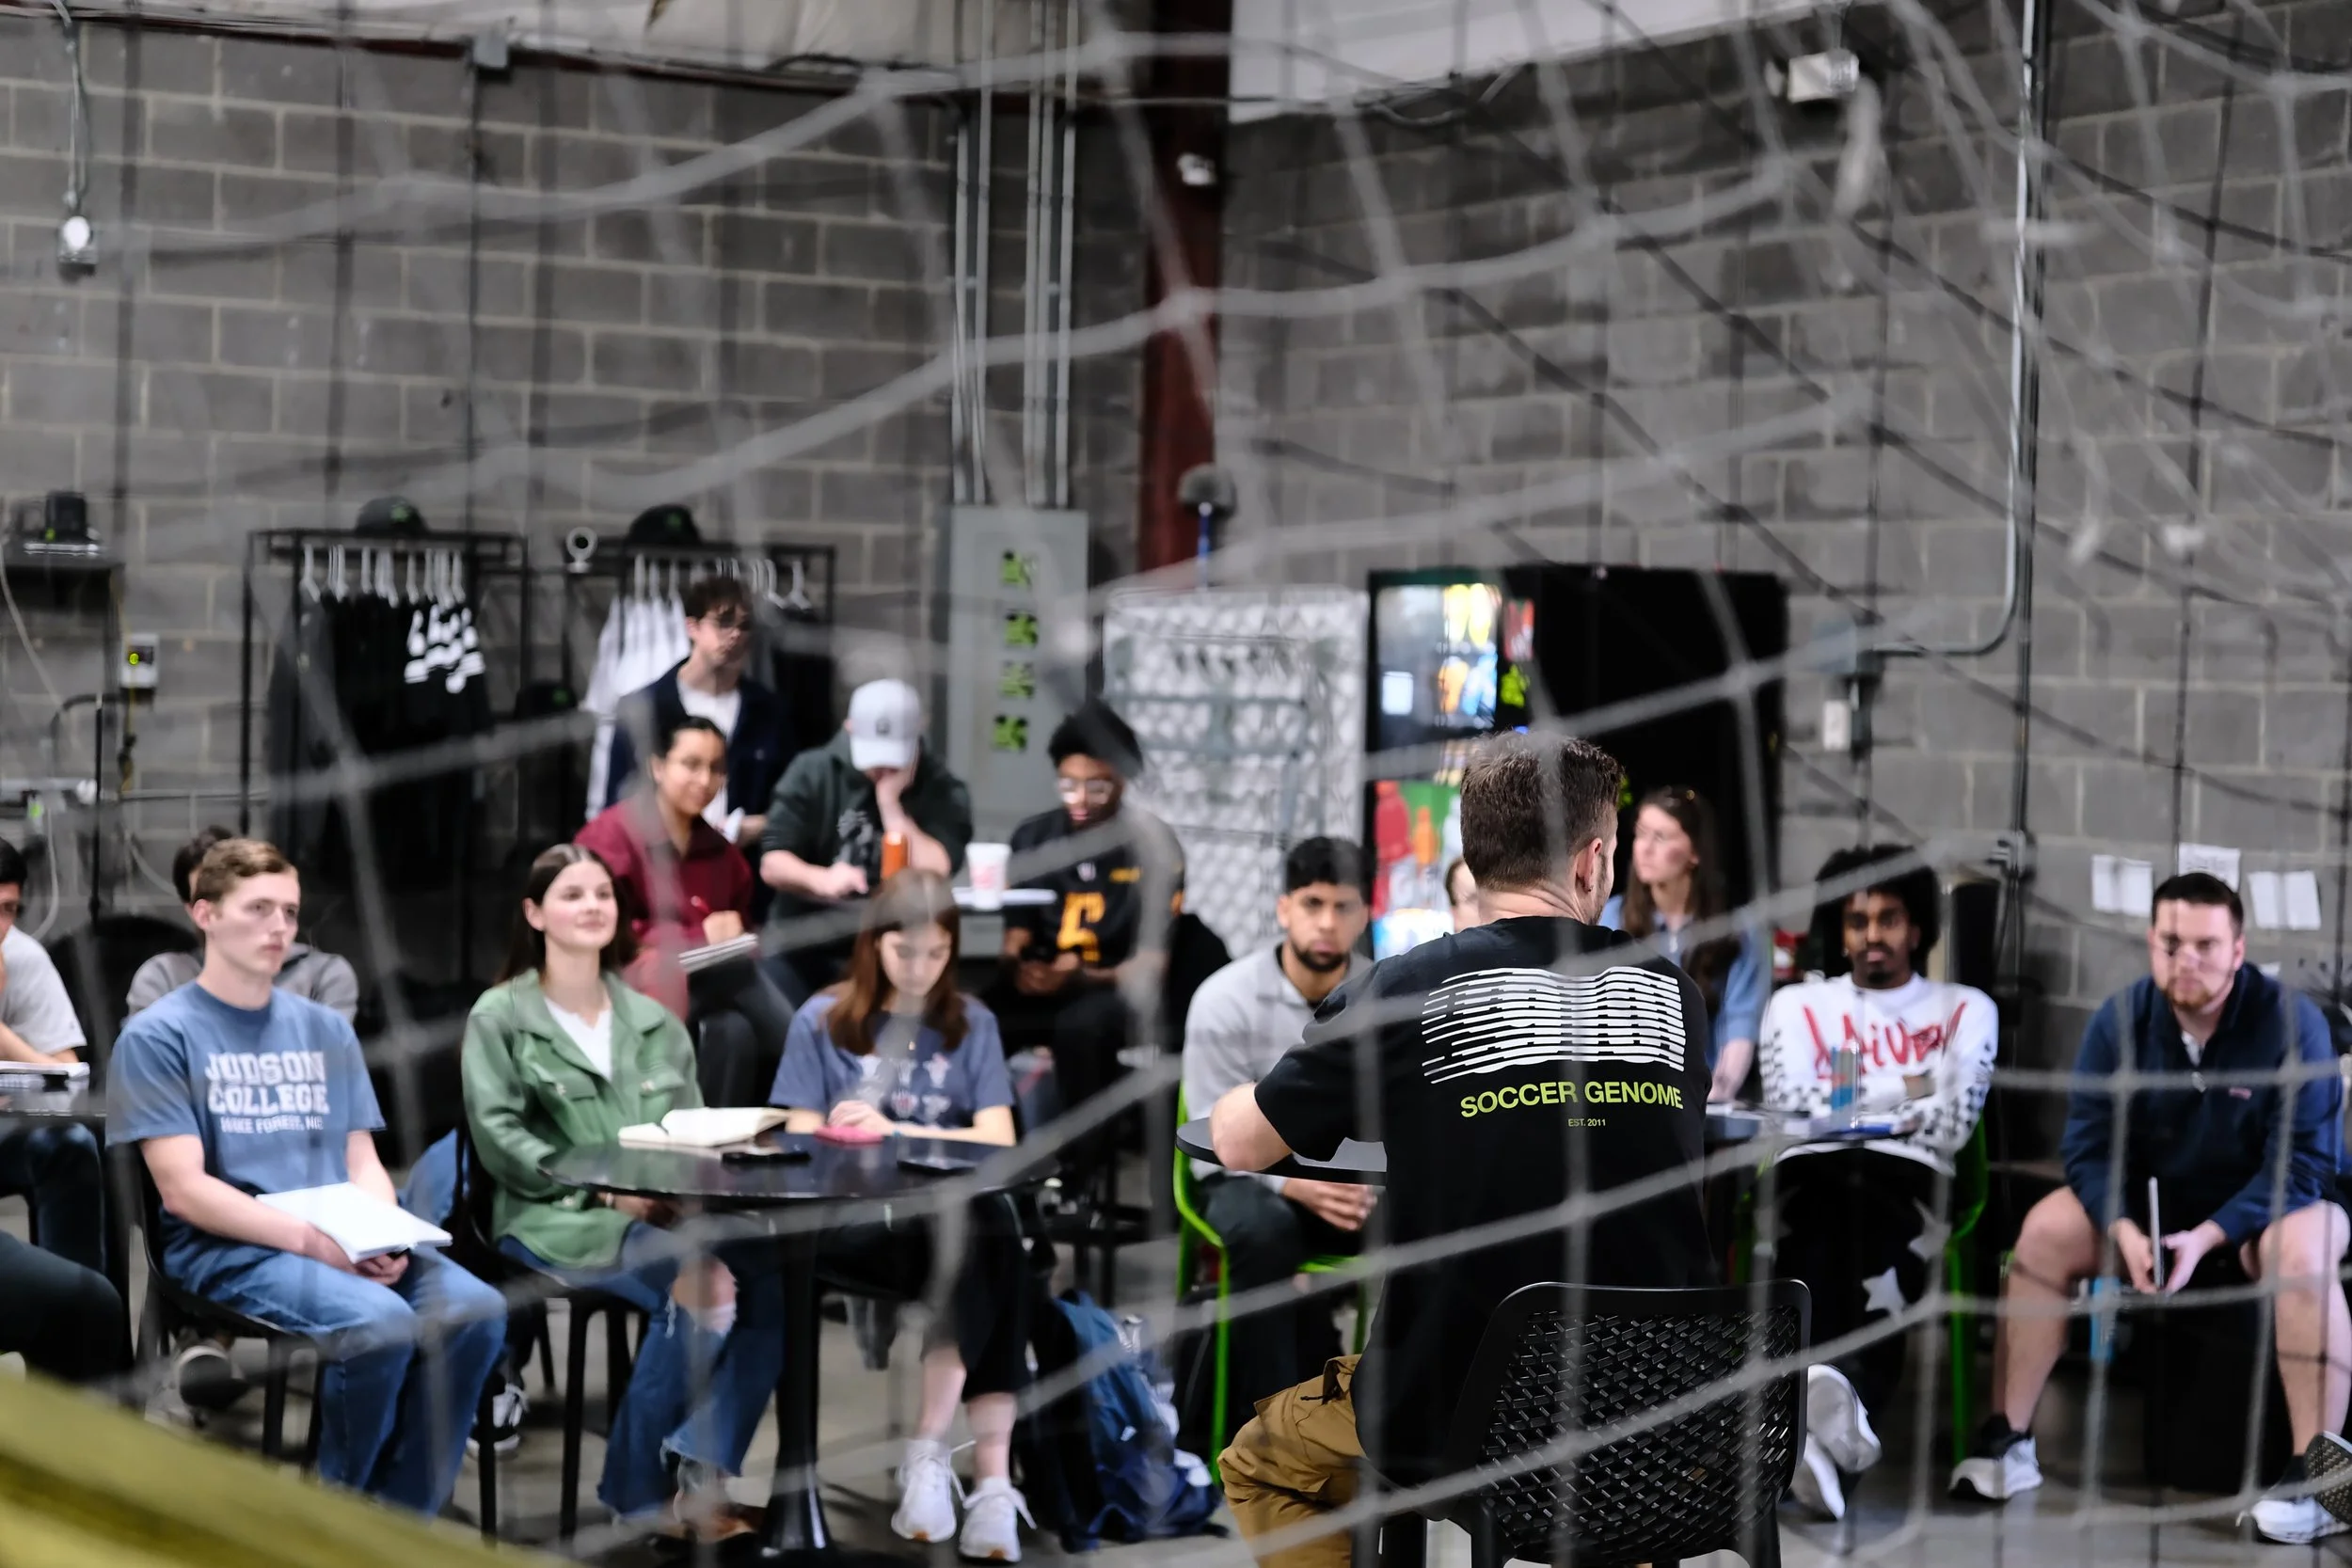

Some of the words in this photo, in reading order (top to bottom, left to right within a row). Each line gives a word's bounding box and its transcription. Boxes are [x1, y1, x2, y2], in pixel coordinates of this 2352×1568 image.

[204, 1051, 326, 1085] JUDSON
[208, 1083, 330, 1116] COLLEGE
[1460, 1081, 1579, 1118] SOCCER
[1584, 1081, 1684, 1110] GENOME
[1567, 1117, 1586, 1127] EST.
[1587, 1117, 1606, 1127] 2011
